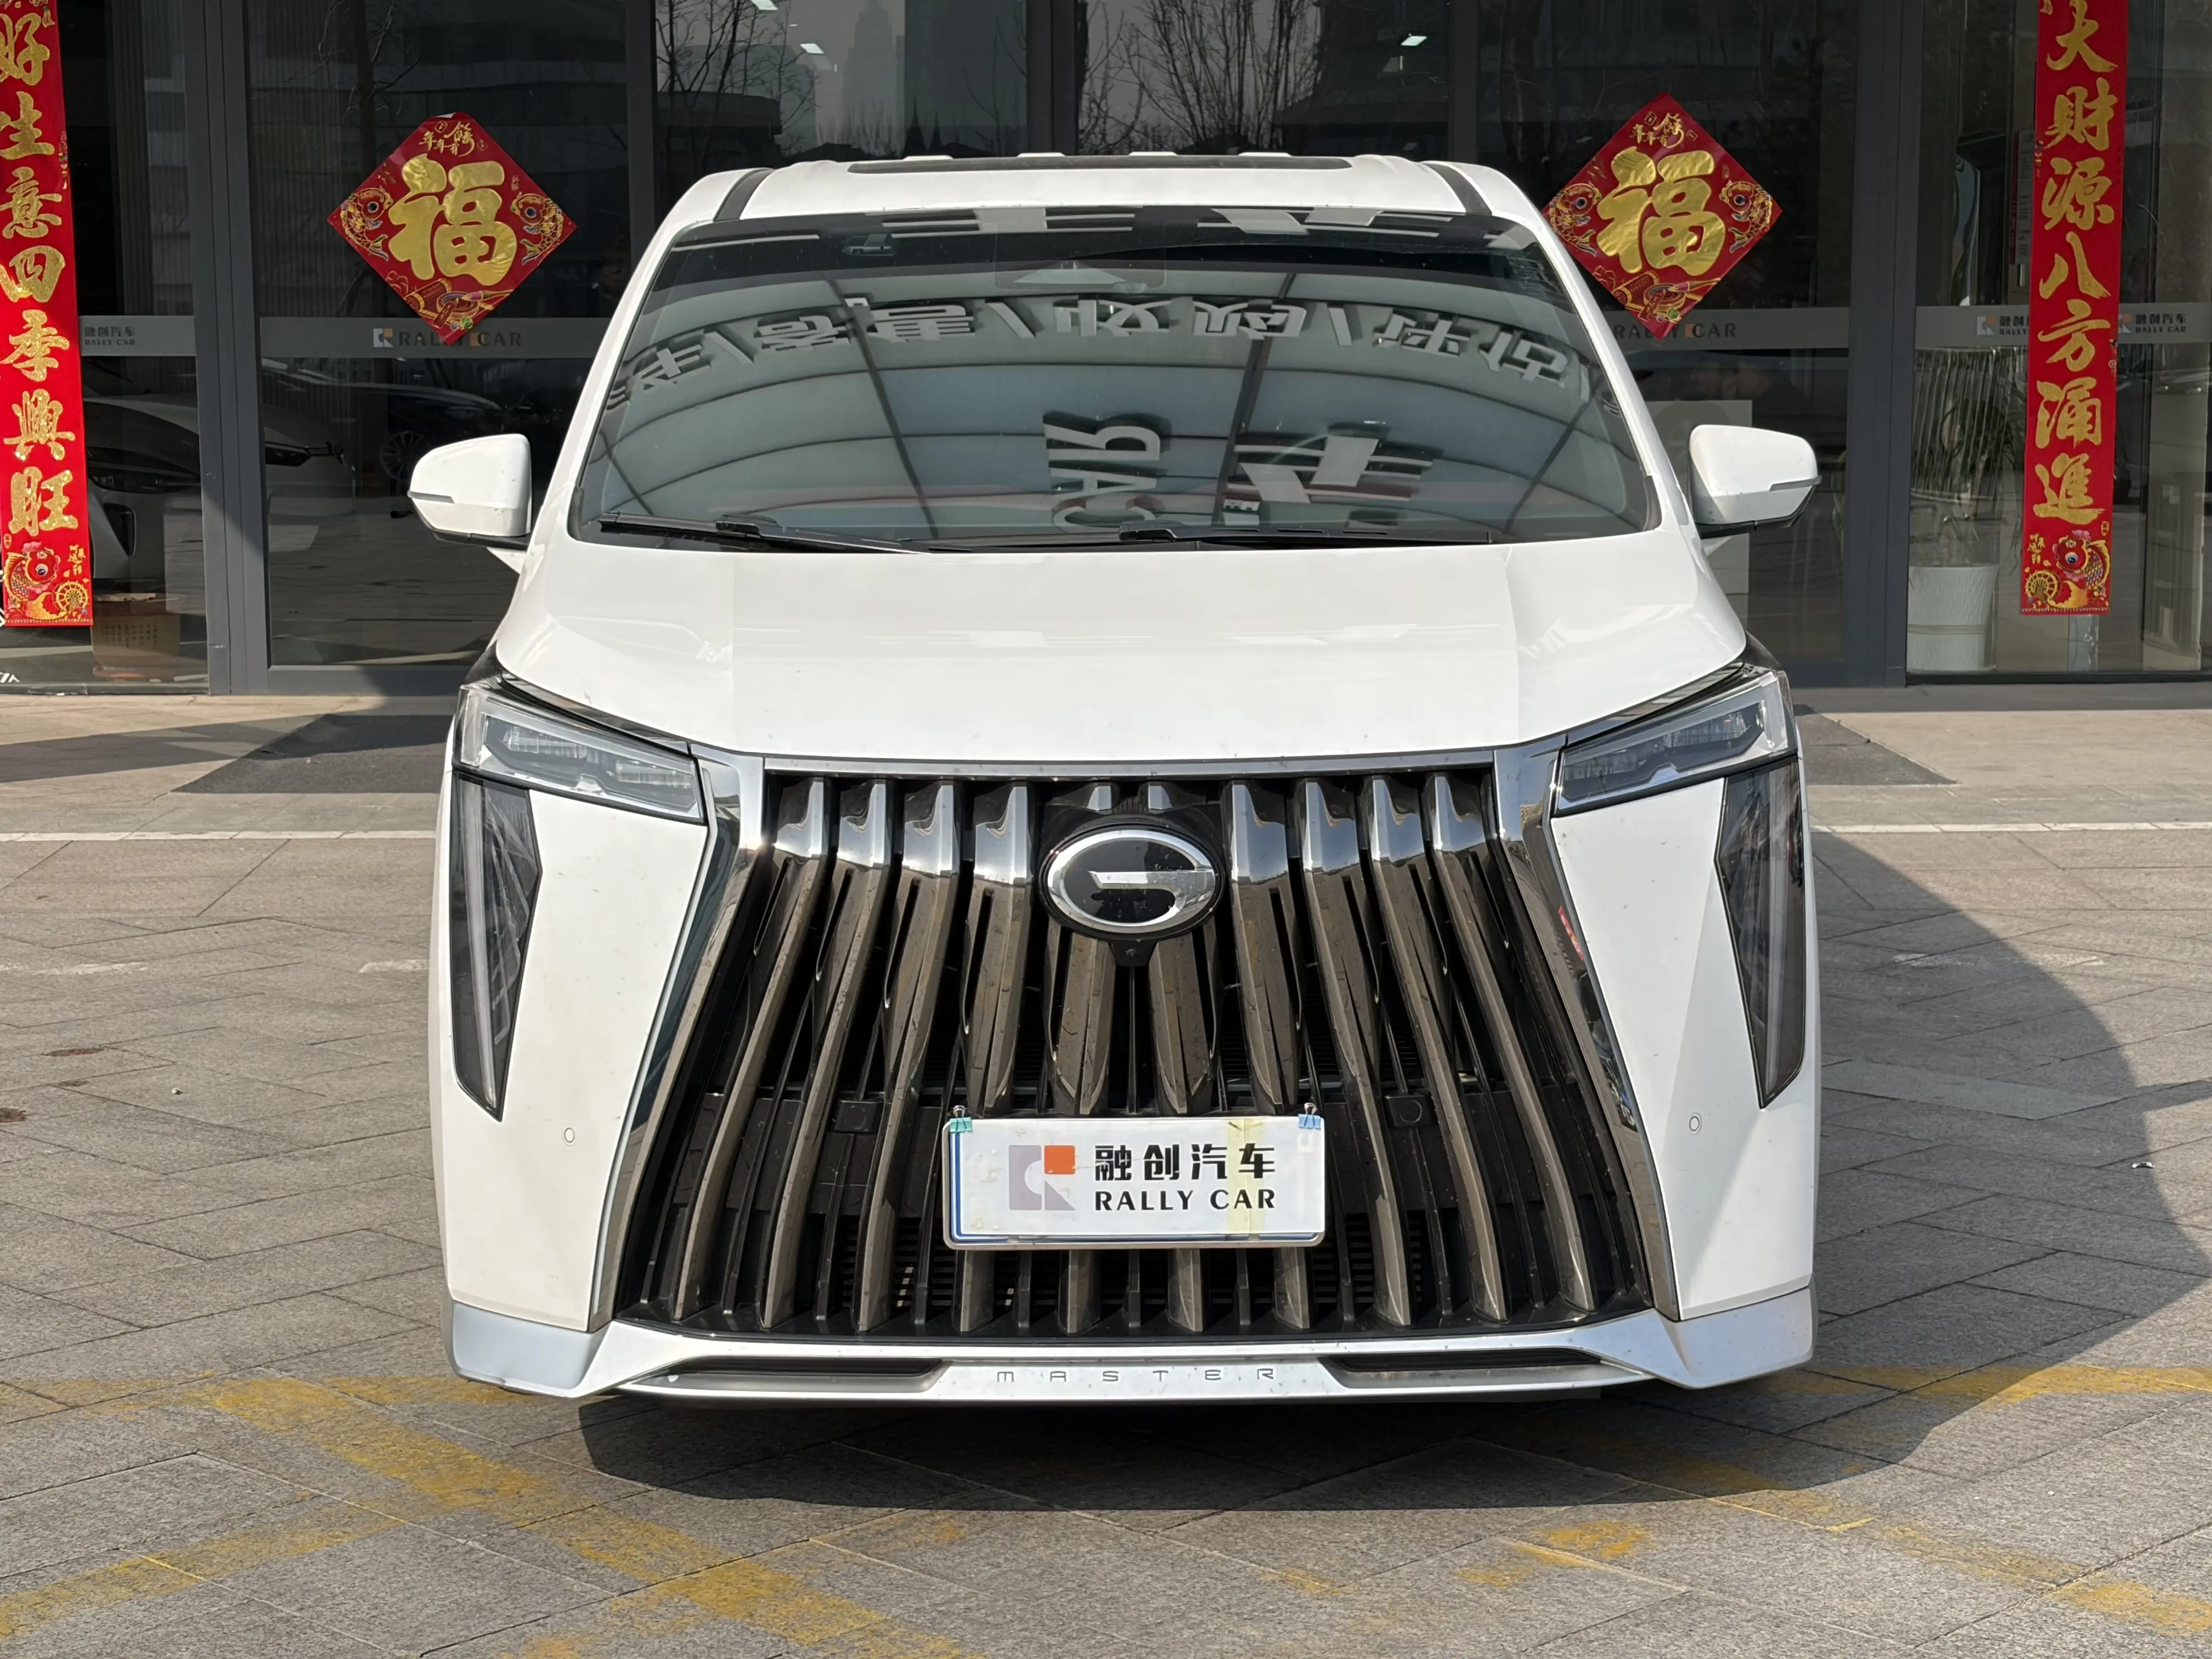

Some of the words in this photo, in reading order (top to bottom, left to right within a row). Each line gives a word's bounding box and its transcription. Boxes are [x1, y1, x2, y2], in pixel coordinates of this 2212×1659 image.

[388, 154, 517, 286] 福
[1597, 146, 1725, 276] 福
[477, 331, 522, 346] CAR
[1692, 323, 1736, 338] CAR
[1095, 1143, 1276, 1181] 融创汽车
[1095, 1190, 1194, 1211] RALLY
[1210, 1189, 1276, 1210] CAR
[997, 1368, 1274, 1382] MASTER
